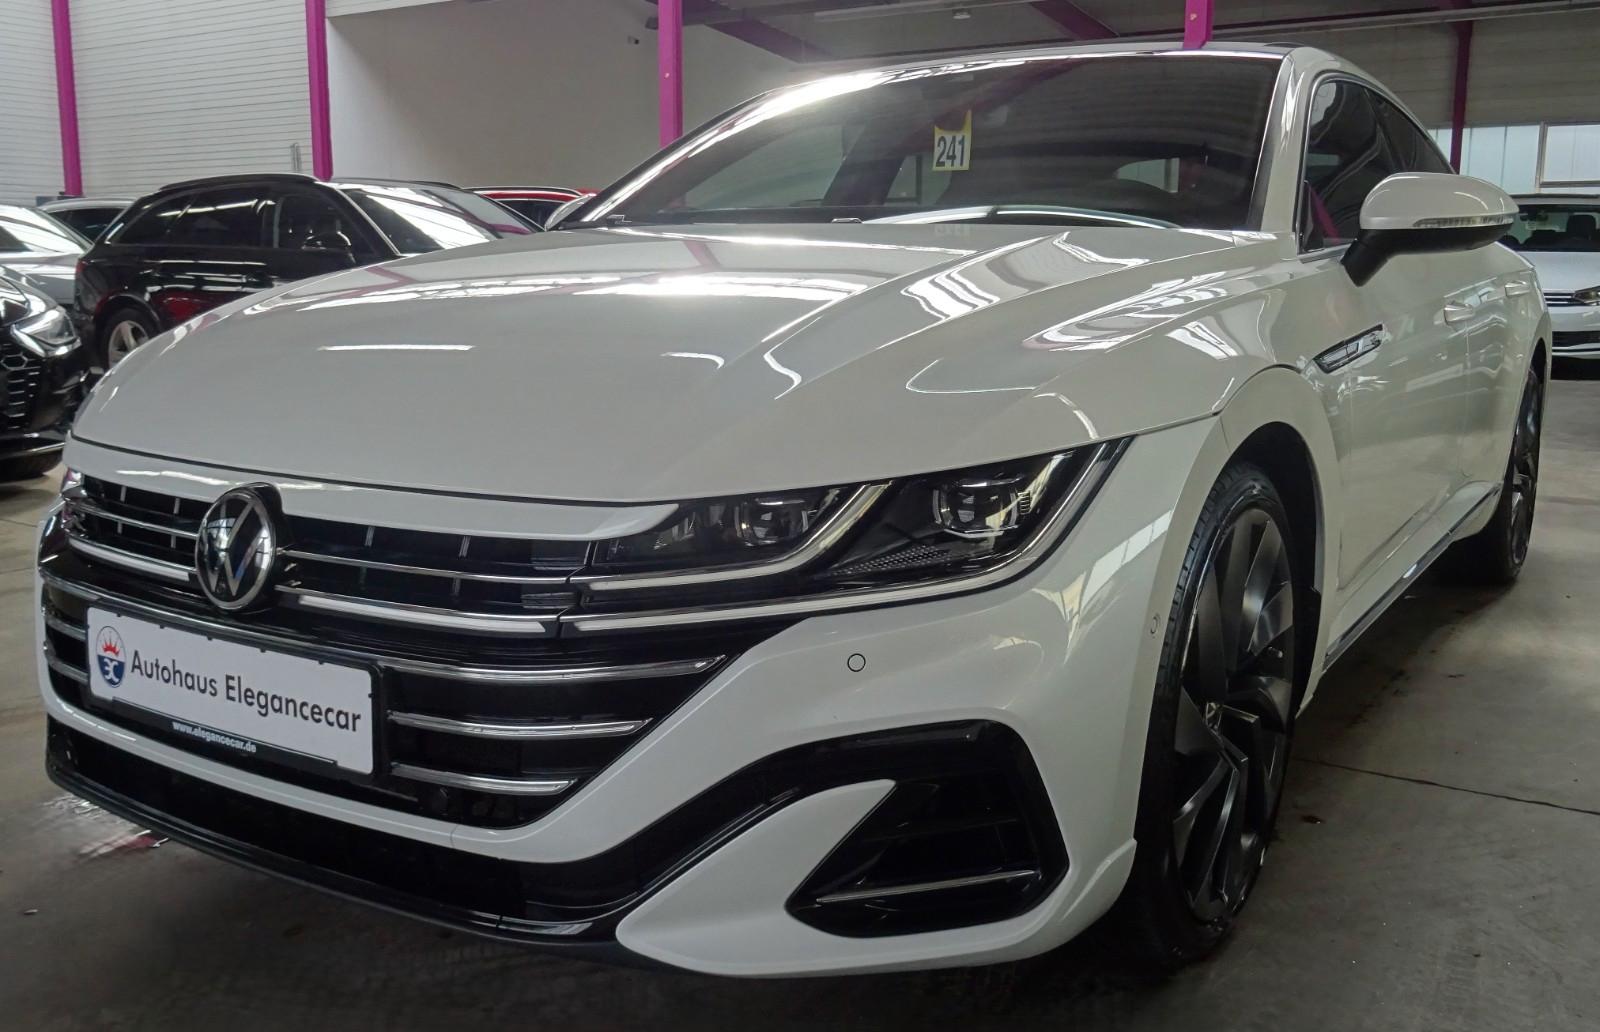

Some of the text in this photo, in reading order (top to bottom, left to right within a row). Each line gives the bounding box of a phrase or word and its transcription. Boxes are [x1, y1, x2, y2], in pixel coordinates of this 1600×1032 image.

[935, 135, 966, 167] 241
[131, 650, 361, 732] Autohaus Elegancecar
[173, 721, 257, 753] www.elegancecar.de
